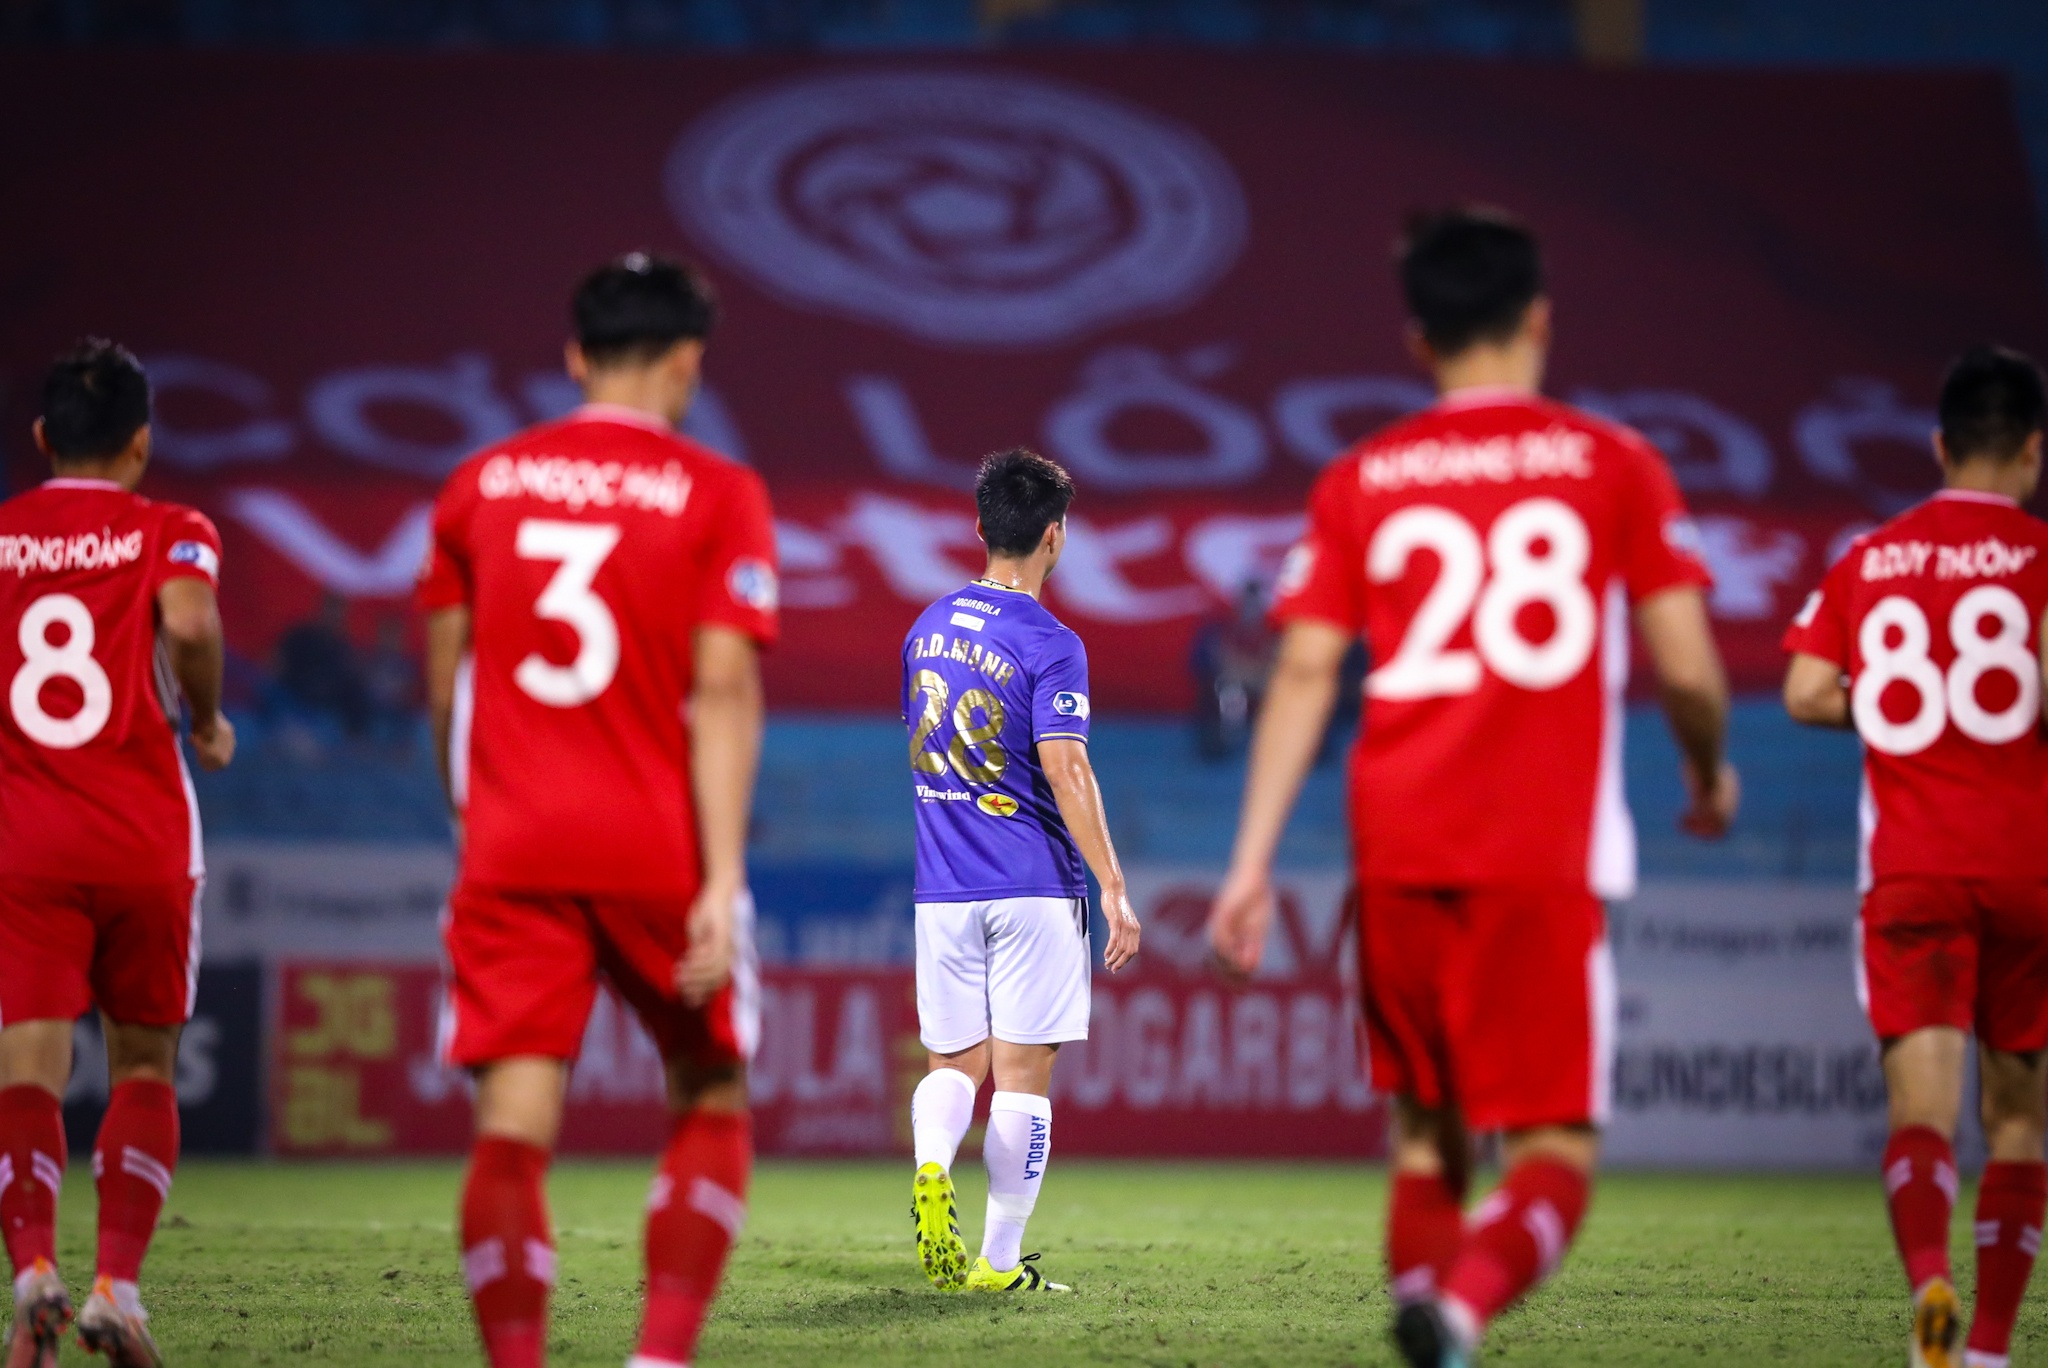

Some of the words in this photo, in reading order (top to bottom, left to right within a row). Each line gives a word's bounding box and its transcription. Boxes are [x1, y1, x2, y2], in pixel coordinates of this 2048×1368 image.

[10, 593, 113, 750] 8
[514, 517, 622, 708] 3
[952, 597, 1001, 616] JOGARBOLA
[1364, 497, 1599, 702] 28
[1851, 584, 2043, 757] 88
[909, 668, 1009, 788] 28
[915, 785, 972, 802] Vinwind
